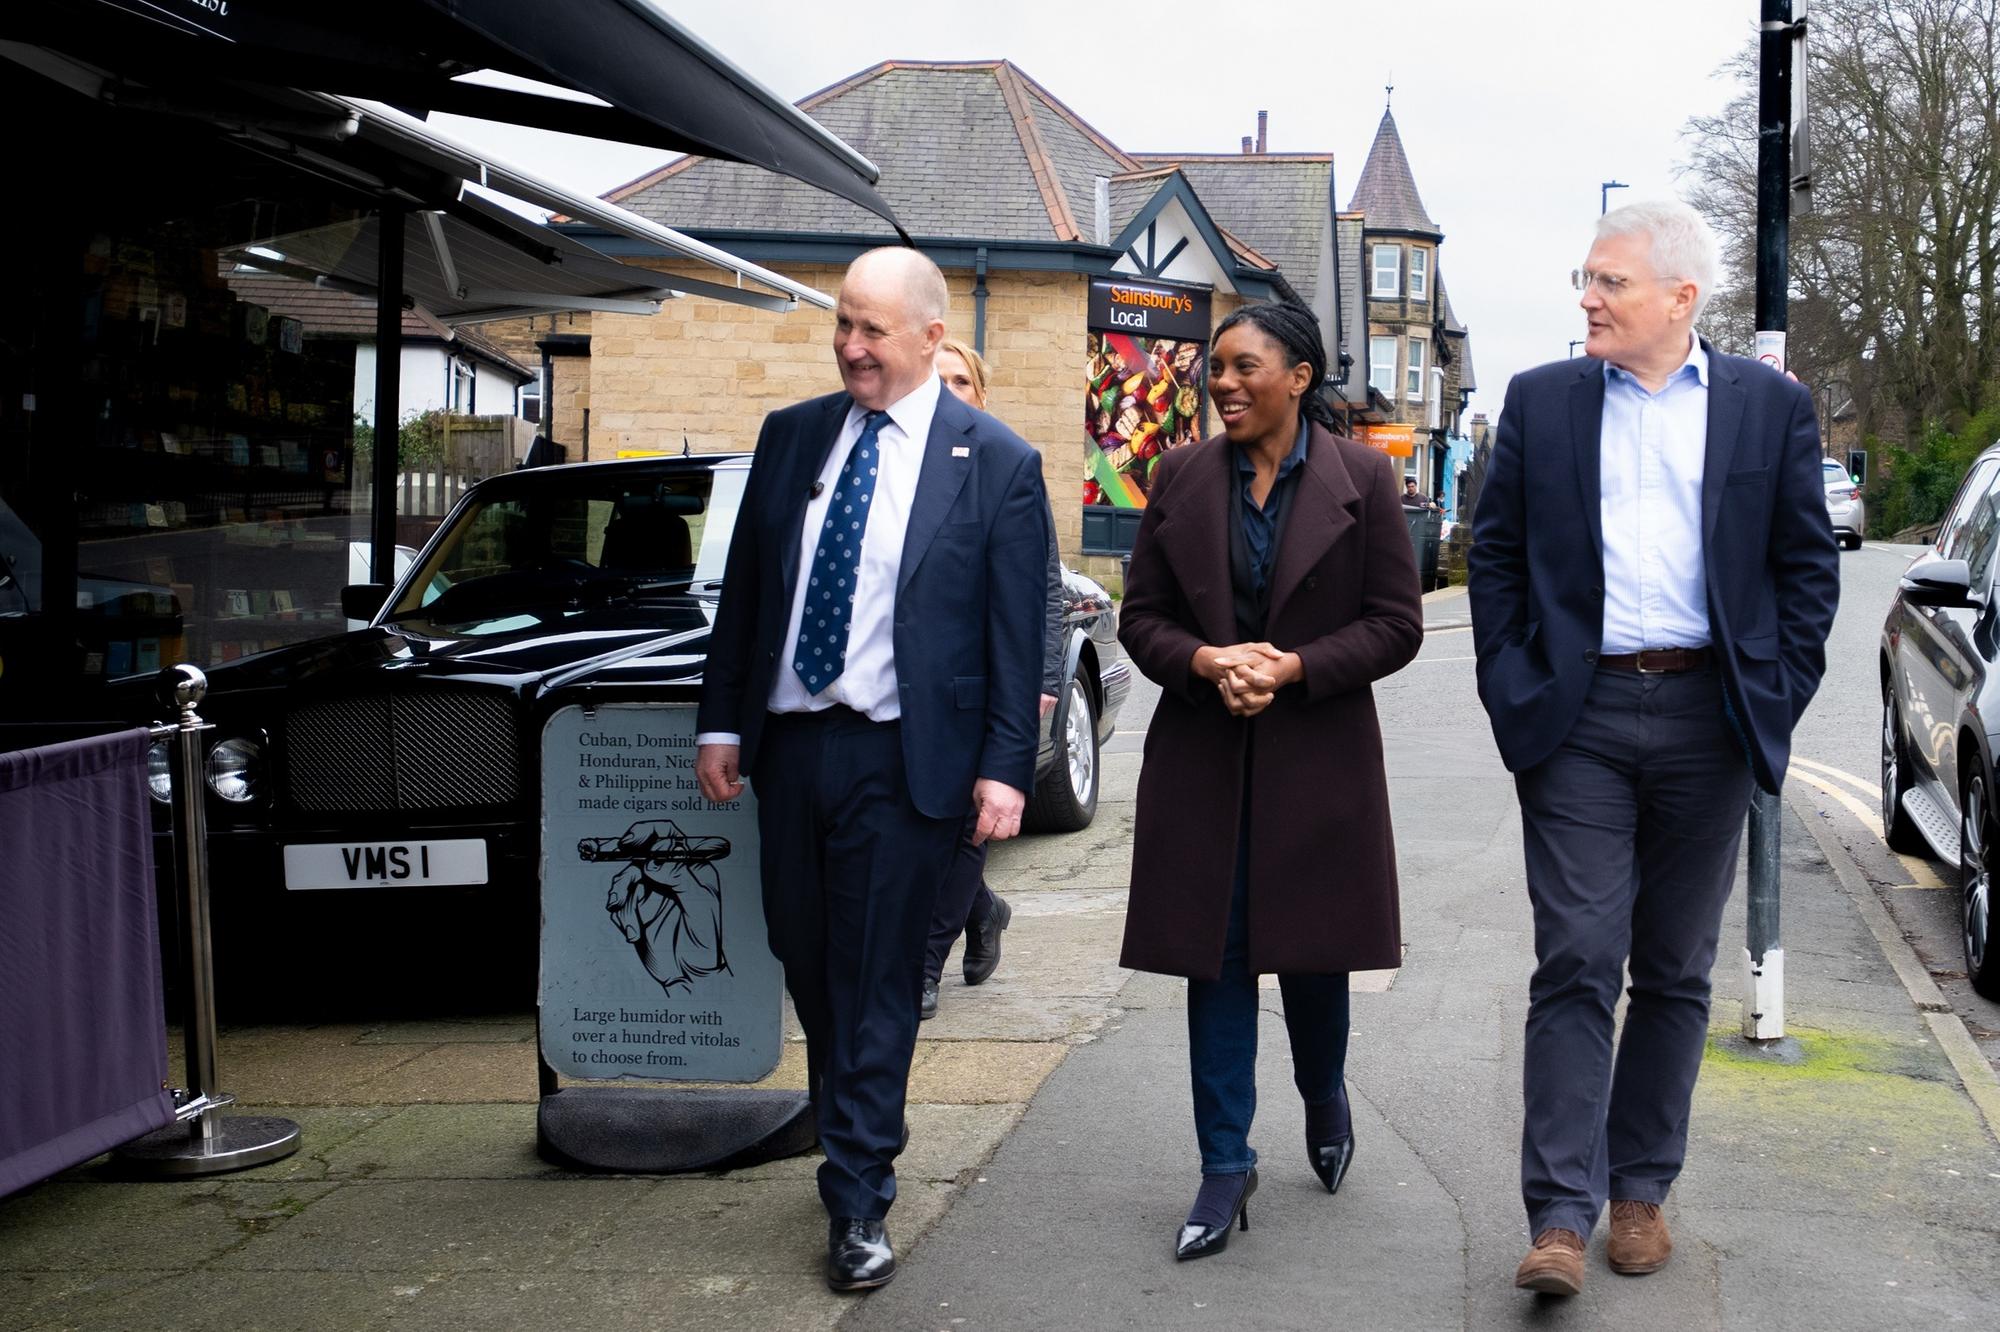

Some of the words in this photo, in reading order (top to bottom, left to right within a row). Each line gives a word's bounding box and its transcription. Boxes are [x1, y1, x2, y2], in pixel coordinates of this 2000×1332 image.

[1110, 285, 1193, 314] Sainsbury's
[1110, 307, 1147, 328] Local
[1367, 431, 1410, 442] Sainsbury's
[579, 732, 632, 749] Cuban,
[637, 733, 698, 748] Domini
[579, 753, 660, 771] Honduran,
[665, 755, 697, 769] Nica
[578, 774, 591, 788] &
[595, 773, 672, 792] Philippine
[578, 795, 619, 809] made
[623, 795, 667, 813] cigars
[671, 796, 702, 811] sold
[707, 799, 740, 812] here
[342, 847, 411, 880] VMS
[573, 1007, 616, 1025] Large
[619, 1008, 686, 1024] humidor
[689, 1010, 723, 1026] with
[572, 1031, 606, 1043] over
[609, 1032, 618, 1043] a
[622, 1028, 686, 1045] hundred
[690, 1031, 740, 1047] vitolas
[572, 1050, 587, 1064] to
[591, 1049, 642, 1064] choose
[646, 1050, 687, 1066] from.
